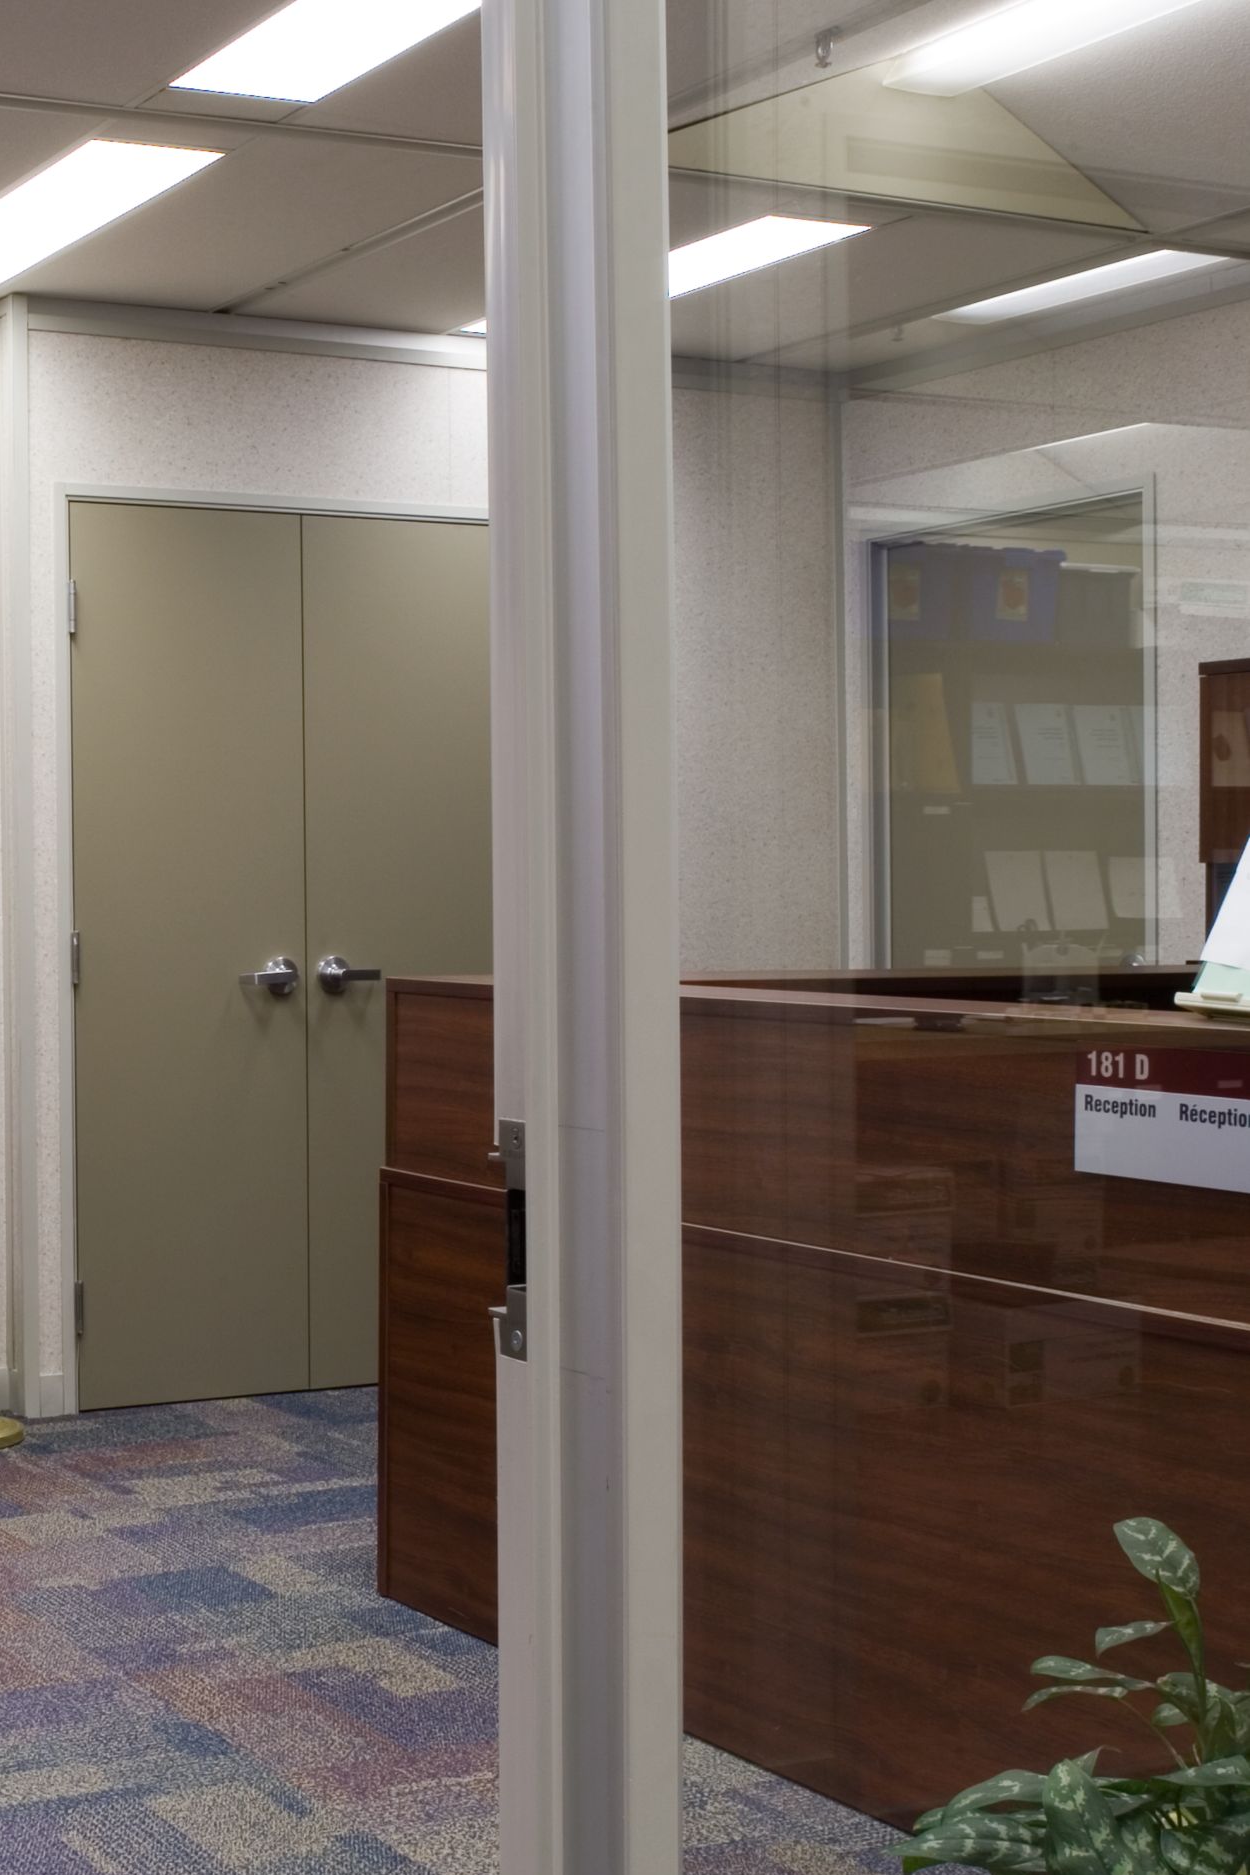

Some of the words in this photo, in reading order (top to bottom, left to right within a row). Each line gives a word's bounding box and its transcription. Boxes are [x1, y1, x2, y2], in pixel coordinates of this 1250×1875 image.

[1087, 1050, 1125, 1079] 181
[1135, 1053, 1150, 1080] D
[1084, 1094, 1157, 1119] Reception
[1179, 1103, 1250, 1129] Réceptio
